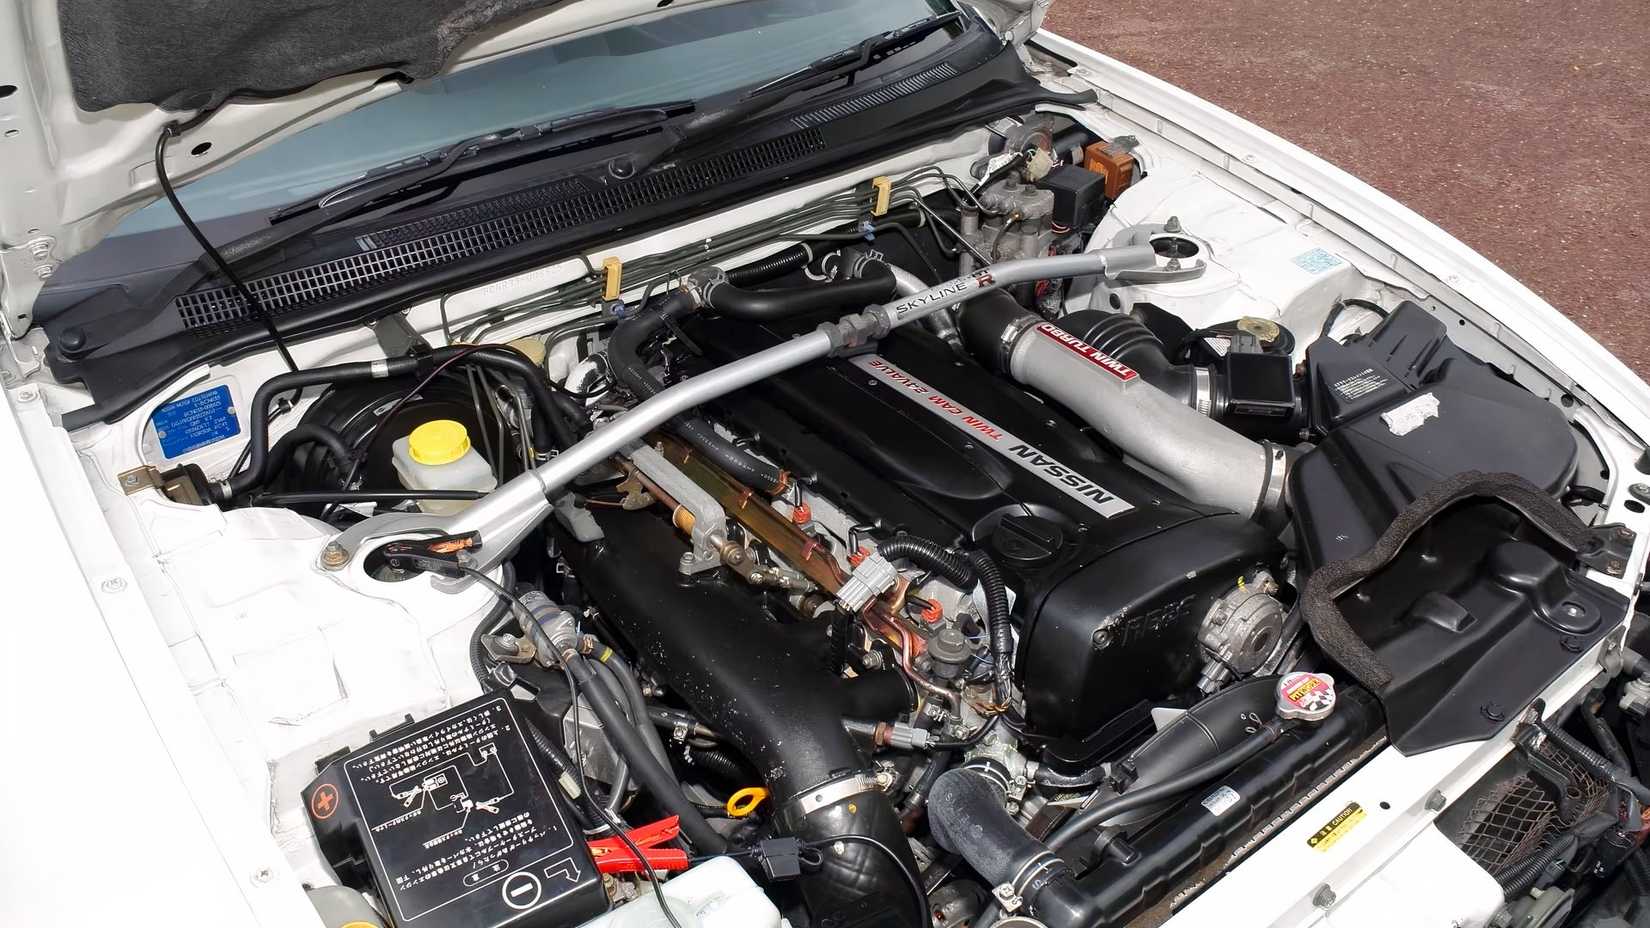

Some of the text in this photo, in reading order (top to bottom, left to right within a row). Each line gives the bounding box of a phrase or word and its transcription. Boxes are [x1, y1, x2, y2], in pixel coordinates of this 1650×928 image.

[896, 282, 968, 314] SKYLINE
[1040, 323, 1130, 376] TWIN TURBO
[867, 358, 1114, 505] NISSAN TWIN CAM 24VALVE
[1331, 807, 1353, 826] CAUTION
